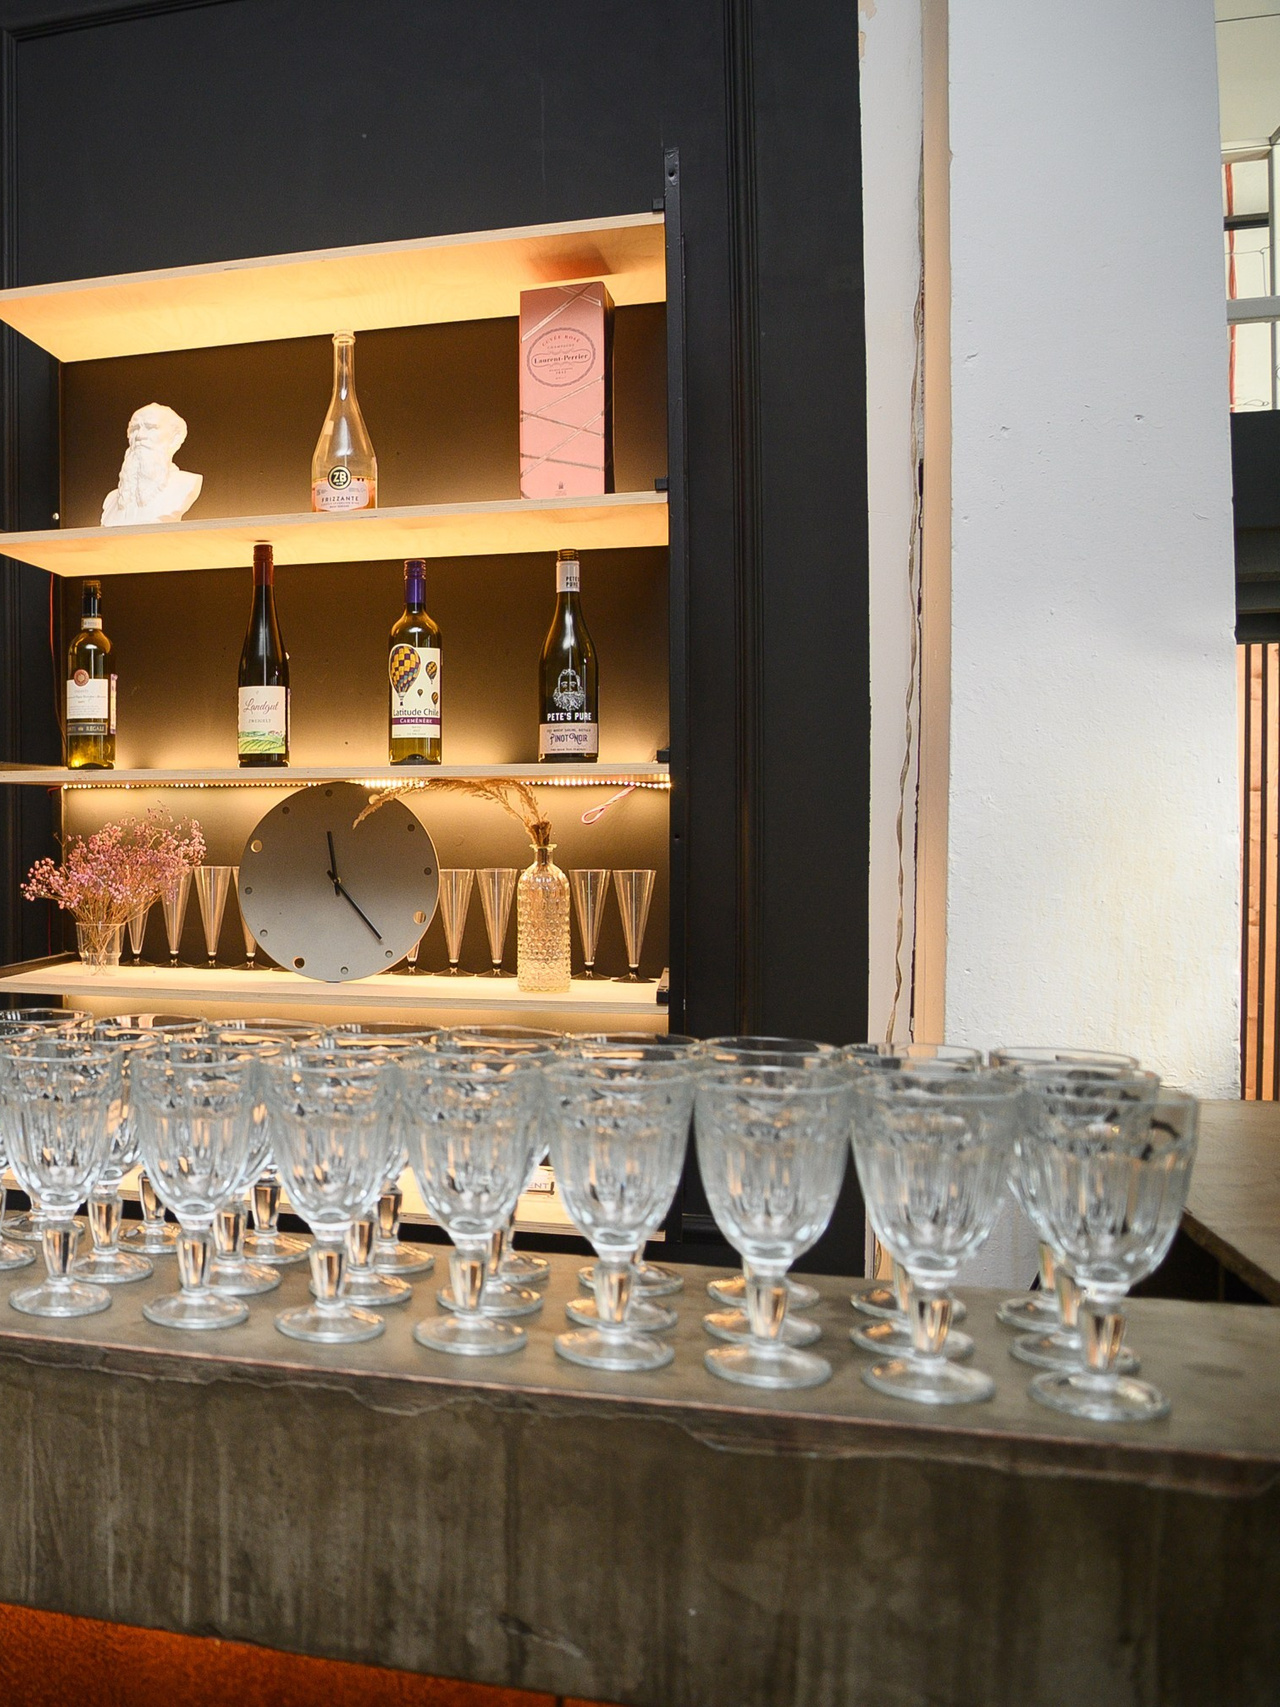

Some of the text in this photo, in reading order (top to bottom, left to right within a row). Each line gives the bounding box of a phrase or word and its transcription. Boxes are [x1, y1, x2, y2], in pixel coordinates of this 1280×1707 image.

[534, 353, 588, 364] Laurent-Perrier
[393, 707, 439, 717] Latitude Chile
[546, 712, 592, 721] PETE'S PURE
